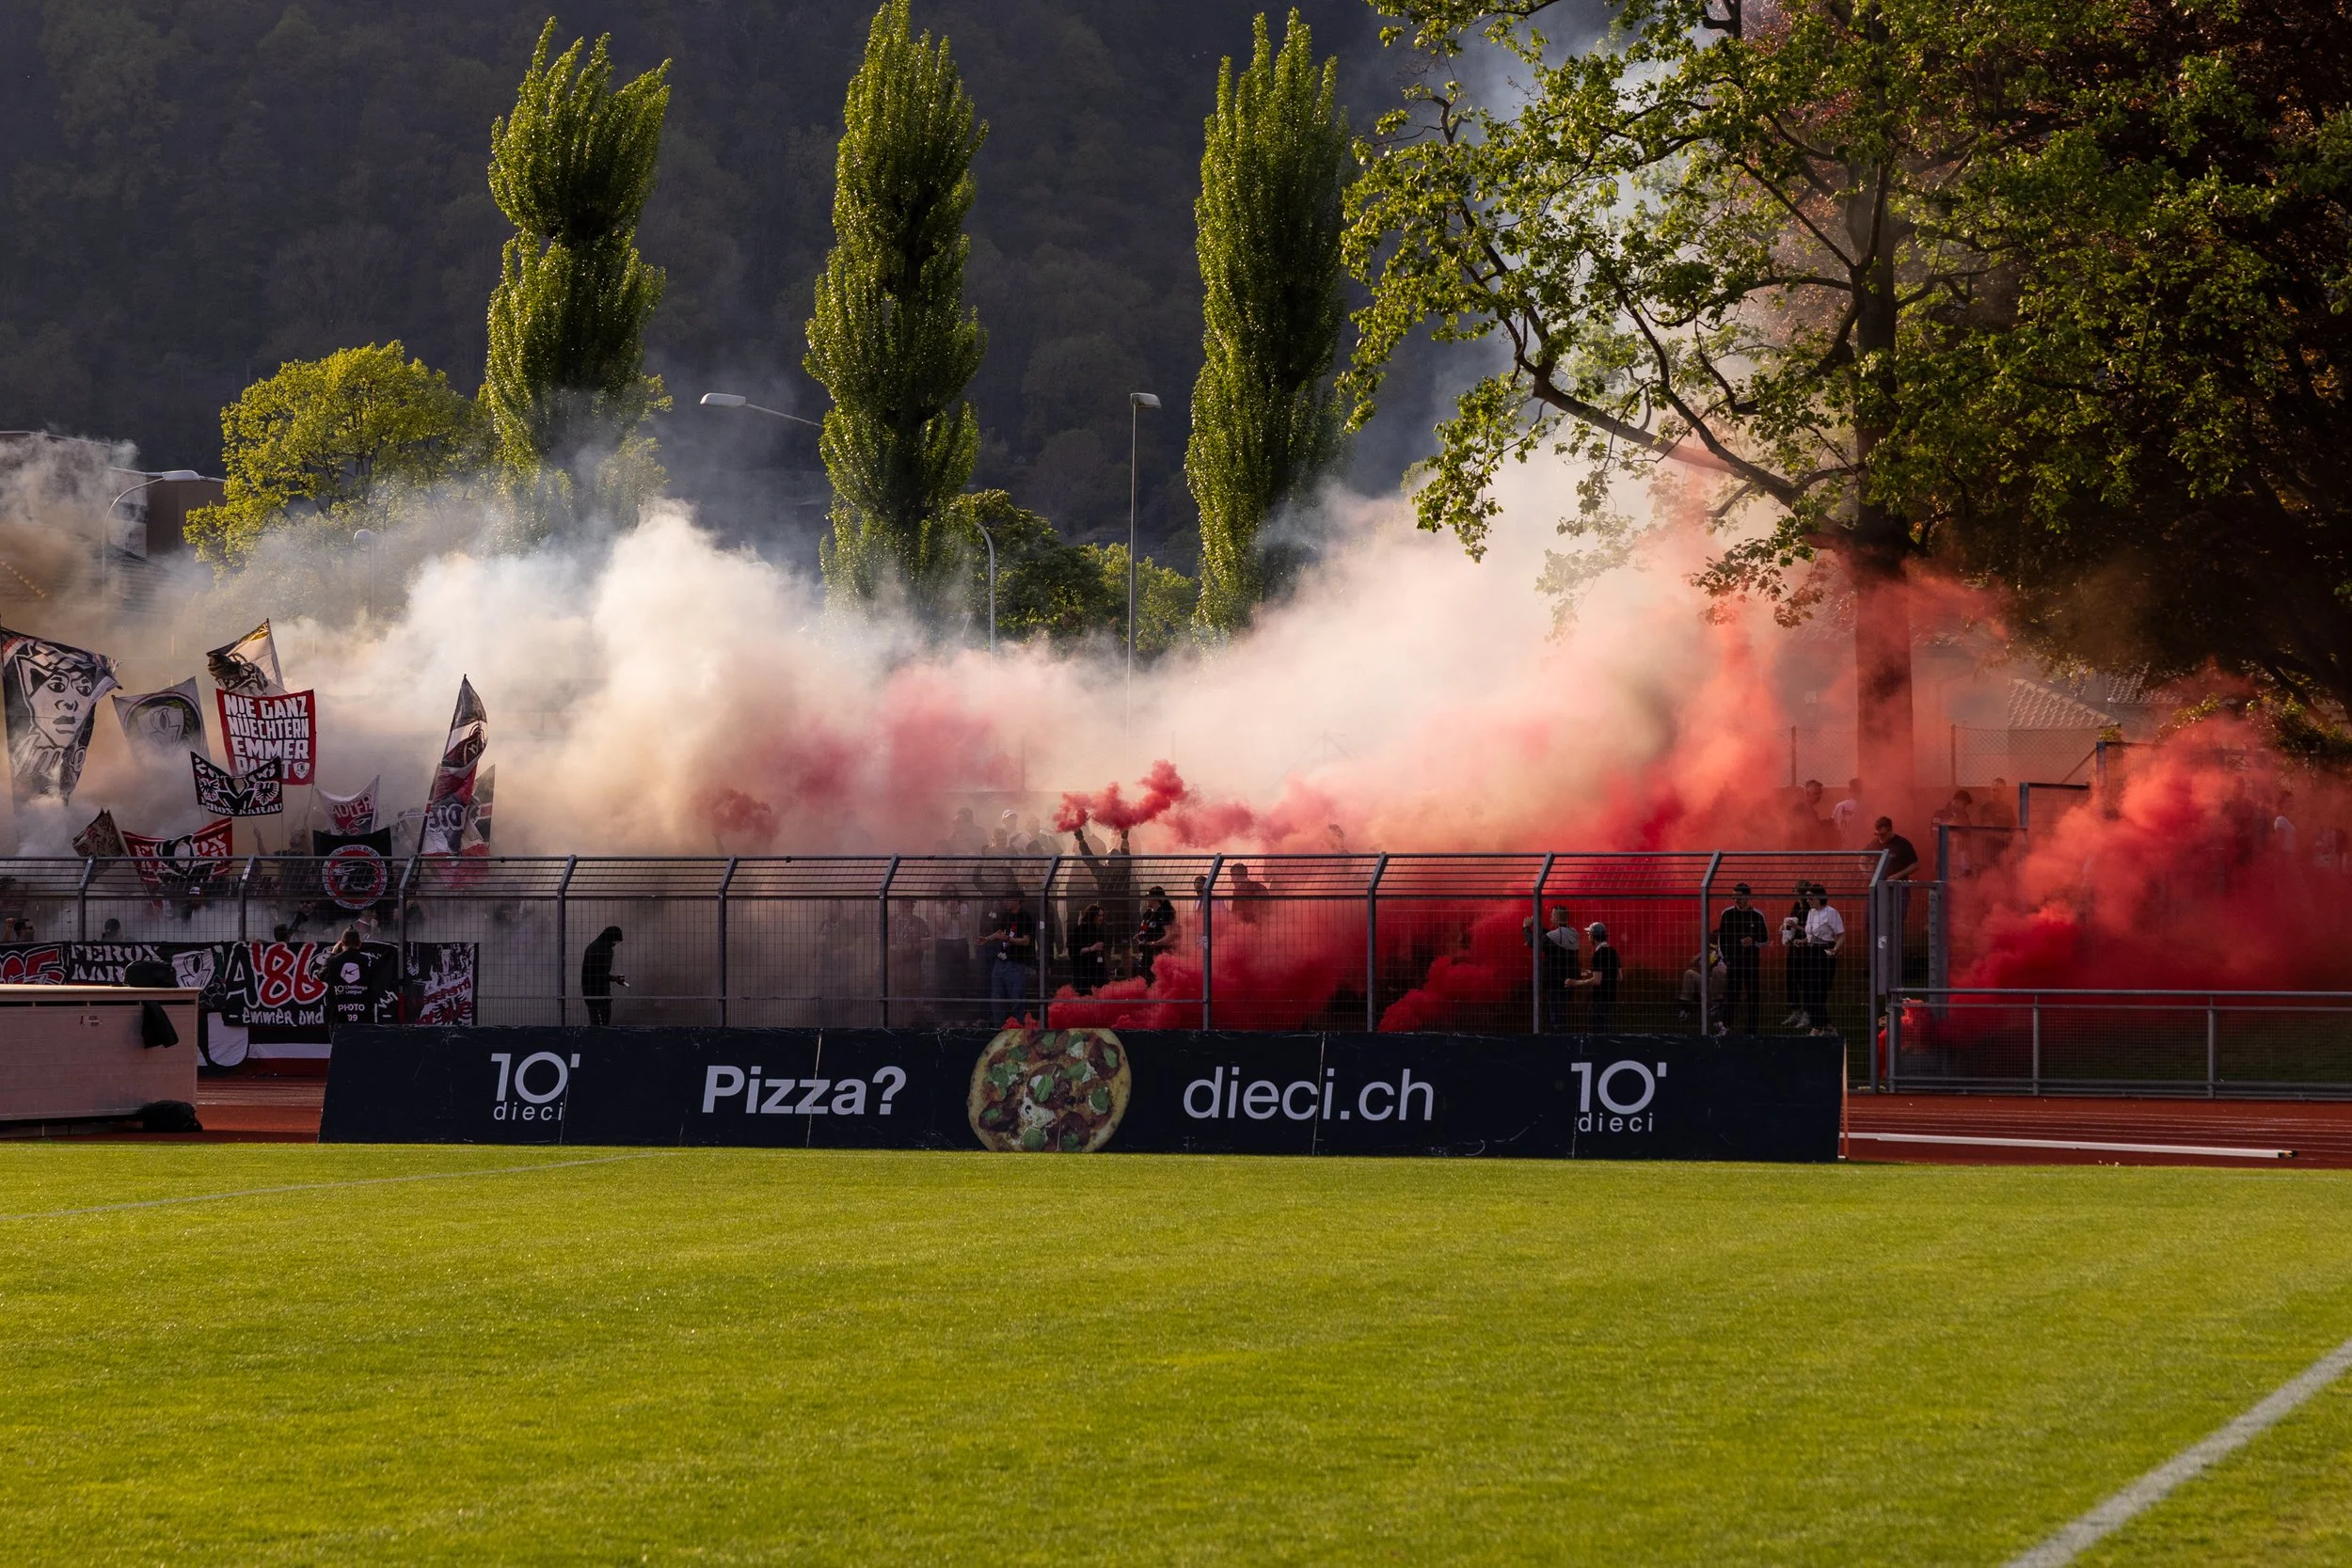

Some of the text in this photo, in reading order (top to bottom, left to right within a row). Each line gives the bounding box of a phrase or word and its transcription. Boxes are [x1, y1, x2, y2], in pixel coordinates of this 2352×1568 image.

[224, 693, 309, 719] NIE GANZ
[227, 713, 310, 739] NÜECHTERN
[230, 736, 310, 760] EMMER
[234, 755, 292, 780] PAT
[70, 943, 162, 962] FEROX
[70, 962, 126, 983] AAR
[338, 1003, 366, 1012] PHOTO
[702, 1064, 907, 1117] Pizza?
[1184, 1066, 1433, 1121] dieci.ch
[493, 1101, 564, 1121] dieci
[1578, 1112, 1653, 1132] dieci
